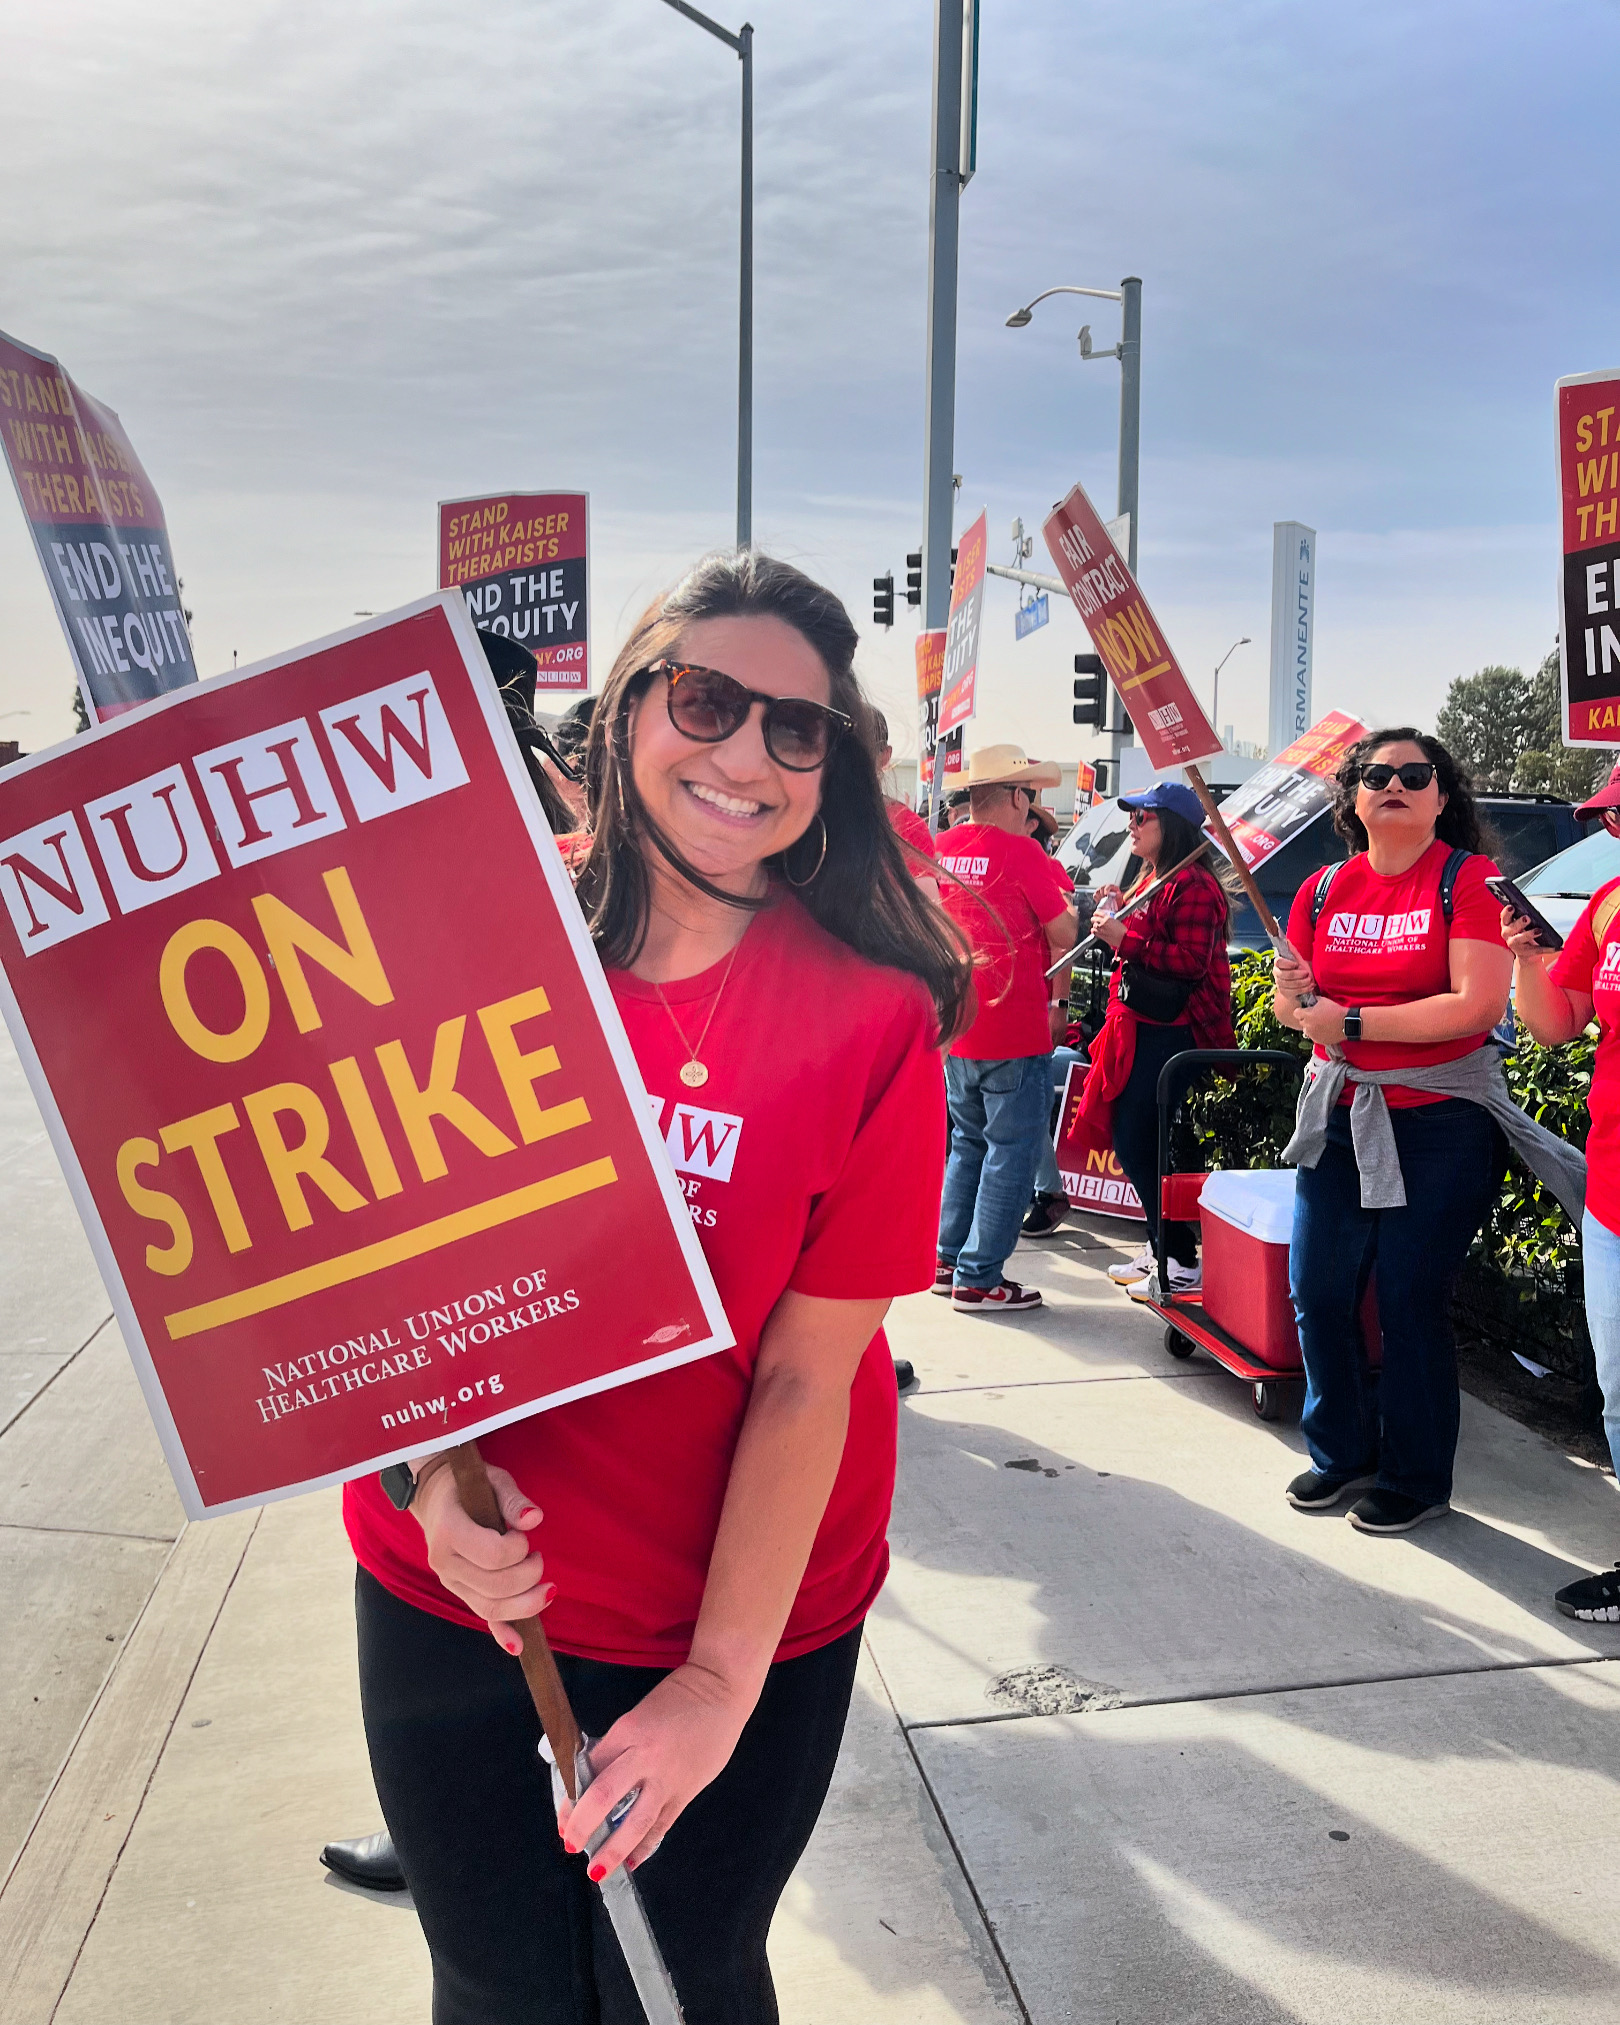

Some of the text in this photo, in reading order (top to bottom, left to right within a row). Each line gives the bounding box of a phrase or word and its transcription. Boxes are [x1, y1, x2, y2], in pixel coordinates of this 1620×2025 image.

[0, 367, 75, 416] STAND
[9, 418, 73, 465] WITH
[1576, 406, 1620, 453] ST
[1576, 451, 1619, 498] WI
[448, 512, 570, 561] WITH KAISER
[449, 502, 509, 538] STAND
[1576, 497, 1619, 543] TH
[50, 542, 174, 601] END THE
[447, 537, 560, 585] THERAPISTS
[957, 536, 982, 581] AISER
[1059, 524, 1095, 571] FAIR
[465, 568, 564, 616] ND THE
[1071, 553, 1130, 618] CONTRACT
[1586, 557, 1620, 615] E
[950, 596, 975, 648] THE
[1094, 599, 1161, 678] NOW
[536, 646, 584, 665] NY.ORG
[946, 623, 977, 681] UITY
[1294, 569, 1309, 741] RMANENTE
[1585, 623, 1620, 677] IN
[1588, 706, 1620, 731] KAI
[1, 686, 432, 938] NUHW
[1279, 772, 1326, 805] THE
[941, 857, 989, 875] UHW
[1330, 910, 1430, 938] NUHW
[1332, 938, 1379, 948] NATIONAL
[159, 866, 396, 1064] ON
[1325, 943, 1426, 954] HEALTHCARE WORKERS
[115, 986, 593, 1276] STRIKE
[262, 1269, 547, 1392] NATIONAL UNION OF
[255, 1289, 581, 1423] HEALTHCARE WORKERS
[380, 1373, 505, 1429] nuhw.org
